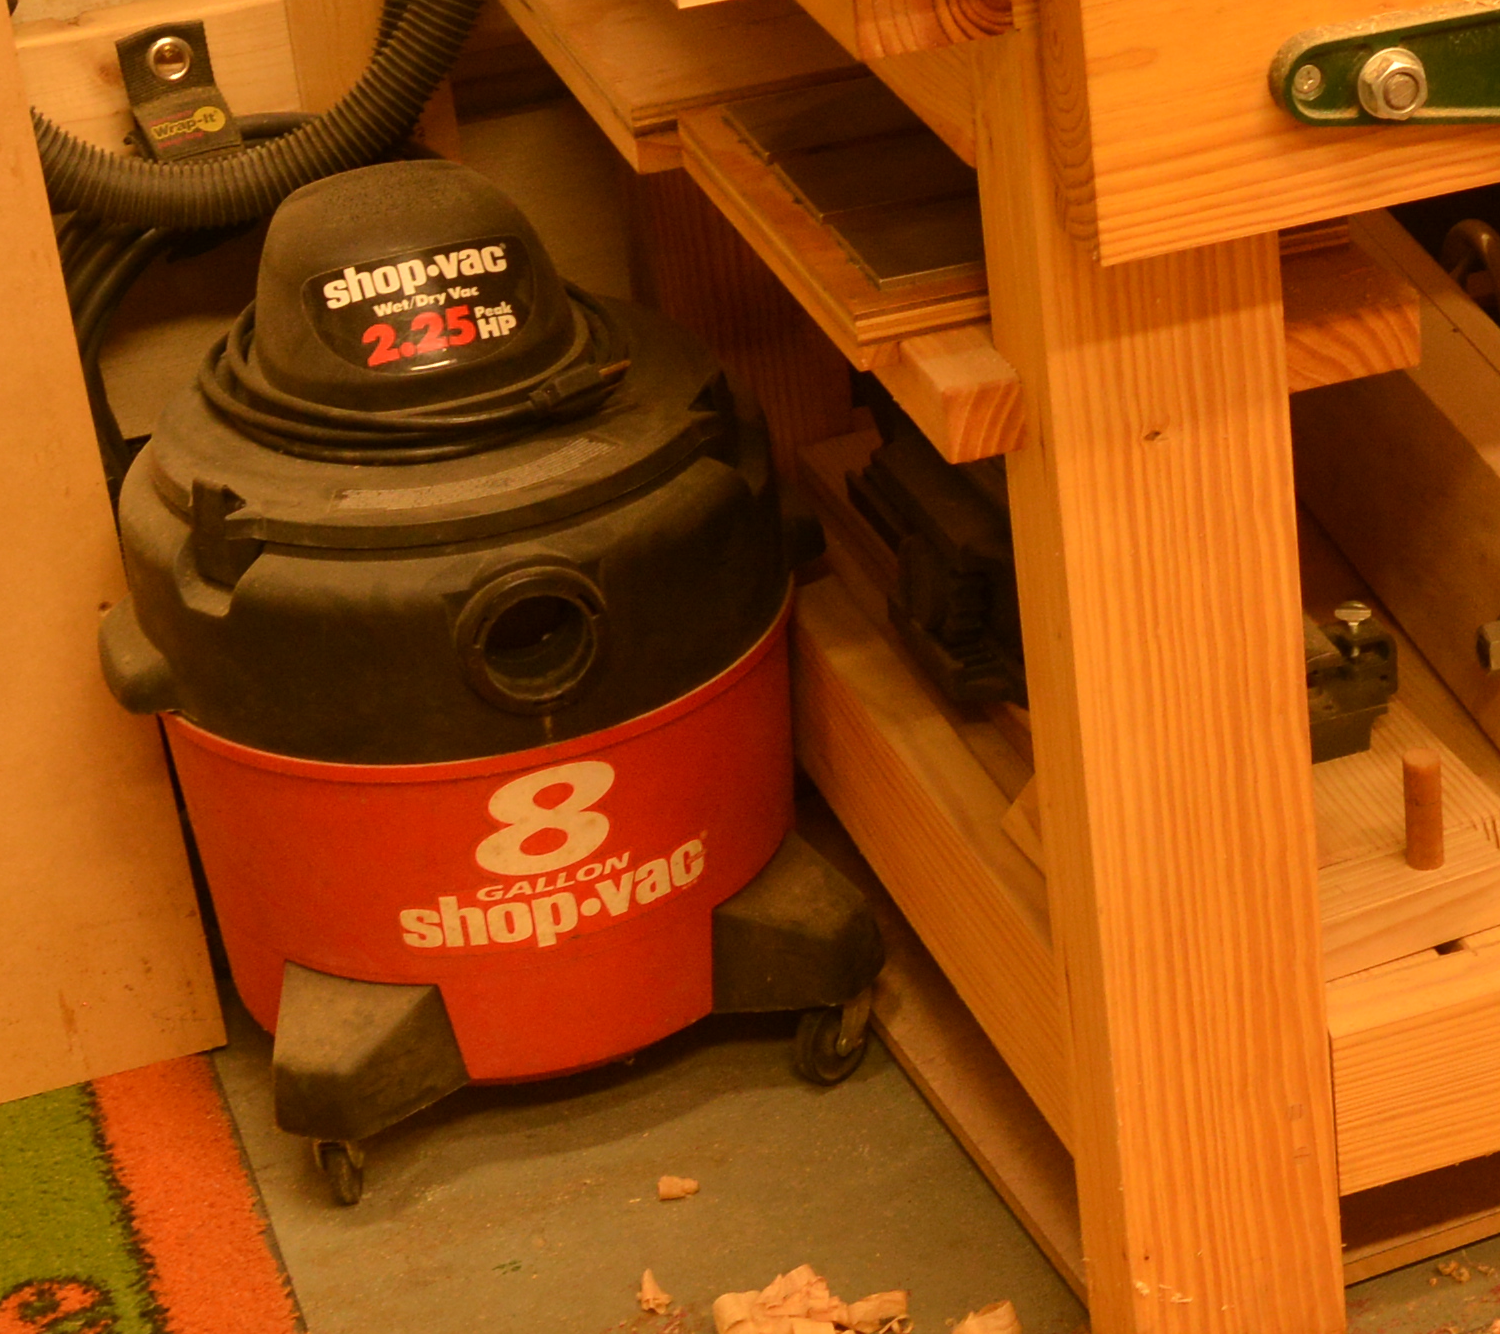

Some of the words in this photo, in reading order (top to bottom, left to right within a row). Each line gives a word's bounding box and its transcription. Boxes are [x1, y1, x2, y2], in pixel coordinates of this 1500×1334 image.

[372, 291, 447, 317] Wet/Dry
[446, 285, 480, 300] Vac
[361, 304, 477, 368] 2.25
[474, 301, 513, 319] Peak
[476, 314, 518, 340] HP
[474, 760, 616, 876] 8
[475, 851, 631, 902] GALLON
